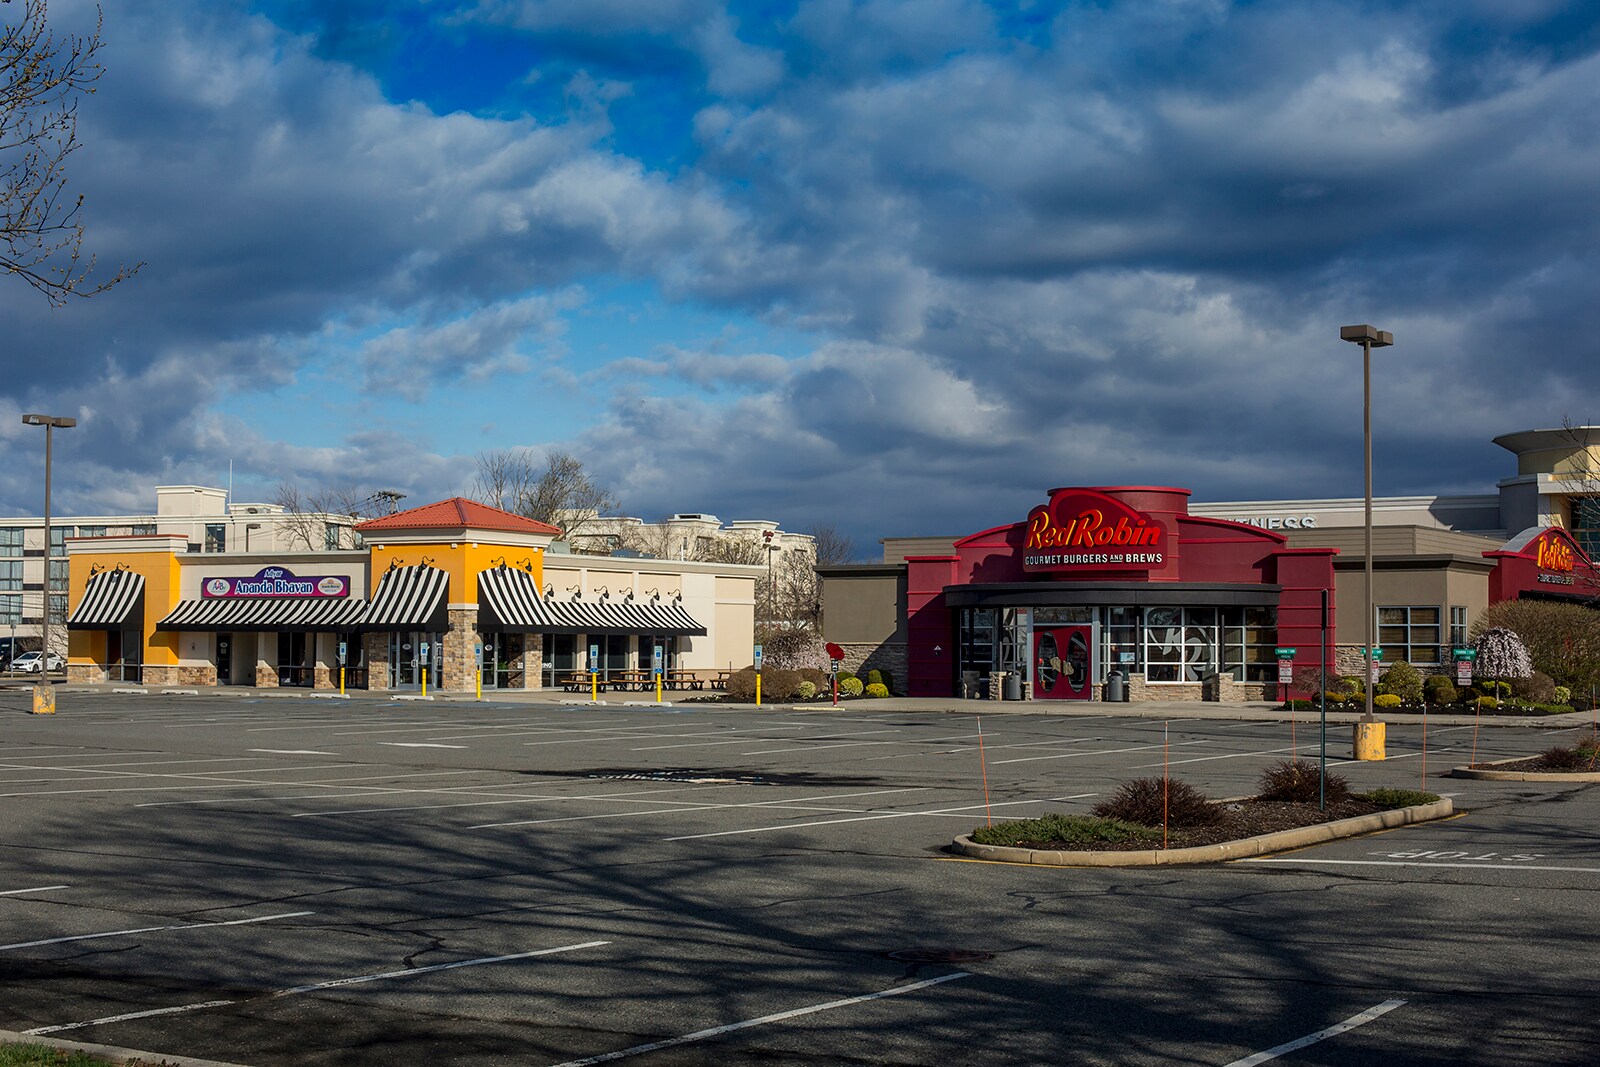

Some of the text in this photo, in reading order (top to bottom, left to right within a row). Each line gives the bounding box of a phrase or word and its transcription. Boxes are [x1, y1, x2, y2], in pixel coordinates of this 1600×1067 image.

[1025, 509, 1161, 549] Red Robin
[1025, 553, 1163, 565] GOURMET BURGERS AND BREWS
[234, 580, 275, 594] Ananda
[274, 579, 314, 594] Bhavan
